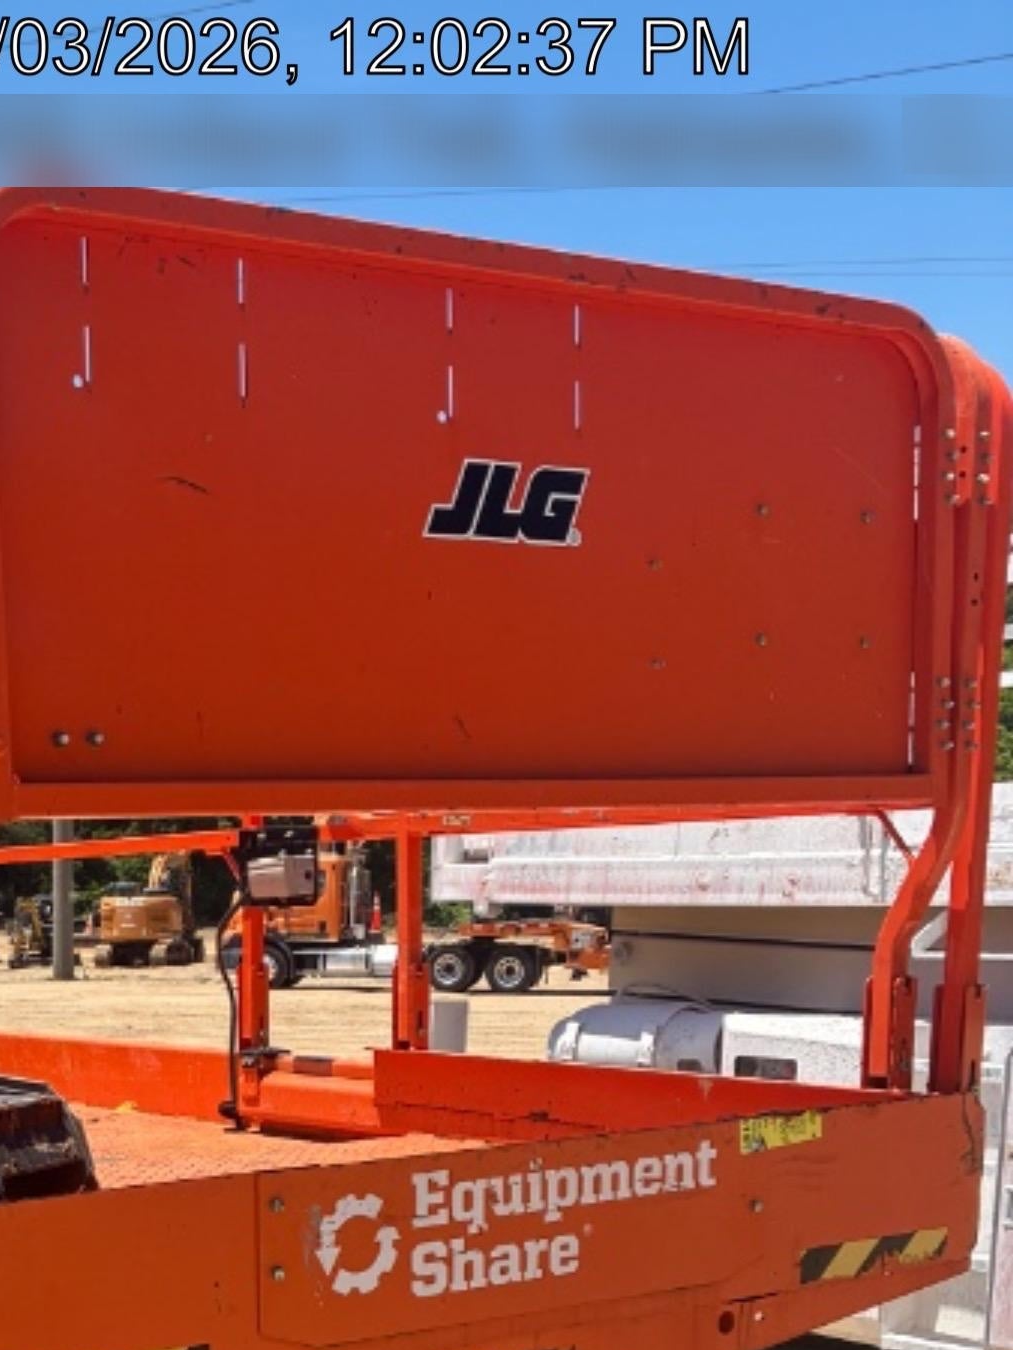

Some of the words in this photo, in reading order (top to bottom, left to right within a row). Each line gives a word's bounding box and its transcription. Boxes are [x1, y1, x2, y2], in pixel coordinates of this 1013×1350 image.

[422, 458, 591, 547] JLG
[411, 1139, 718, 1234] Equipment
[410, 1233, 580, 1298] Share
